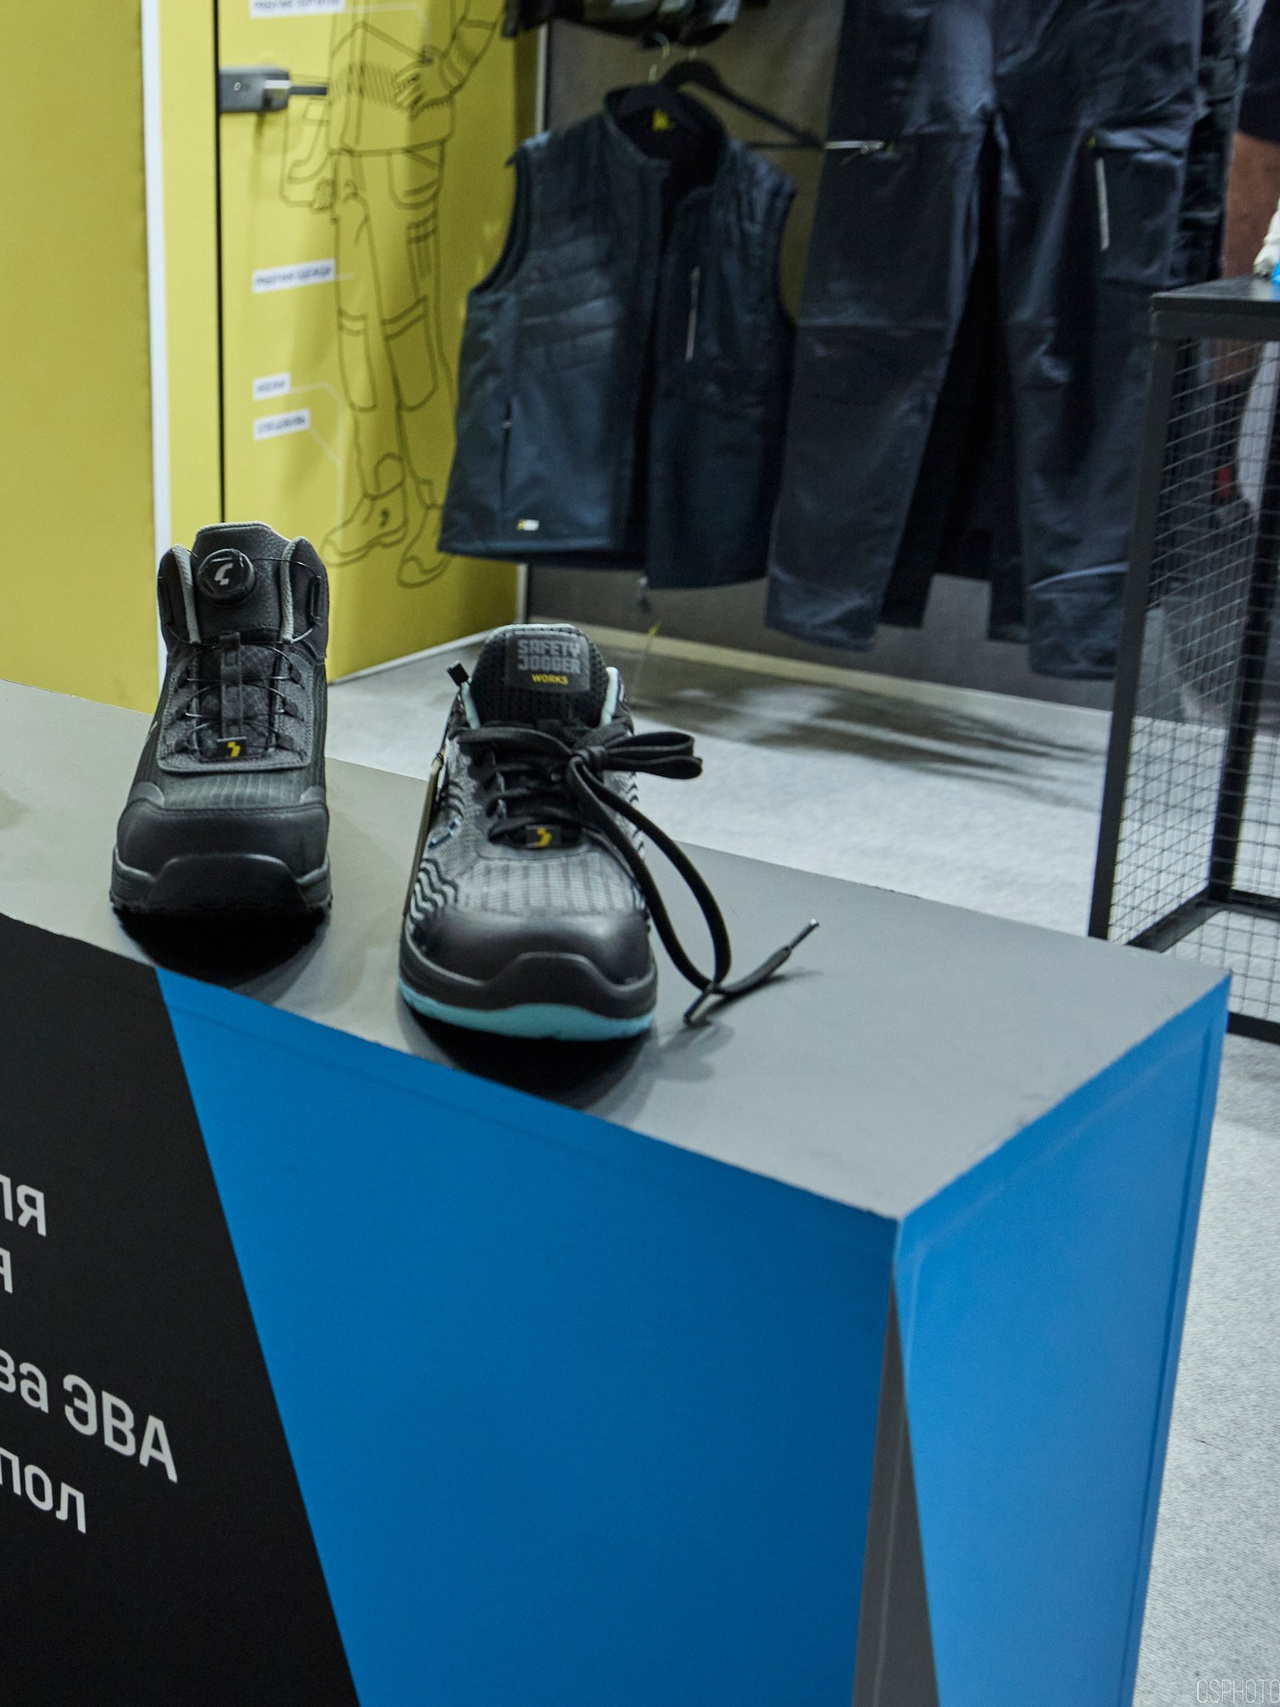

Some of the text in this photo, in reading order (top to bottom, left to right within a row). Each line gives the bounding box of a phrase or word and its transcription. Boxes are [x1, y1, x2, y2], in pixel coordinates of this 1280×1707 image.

[517, 639, 581, 658] SAFETY
[517, 655, 581, 675] JOGGER
[531, 673, 569, 686] WORKS
[62, 1373, 178, 1484] ЭВА
